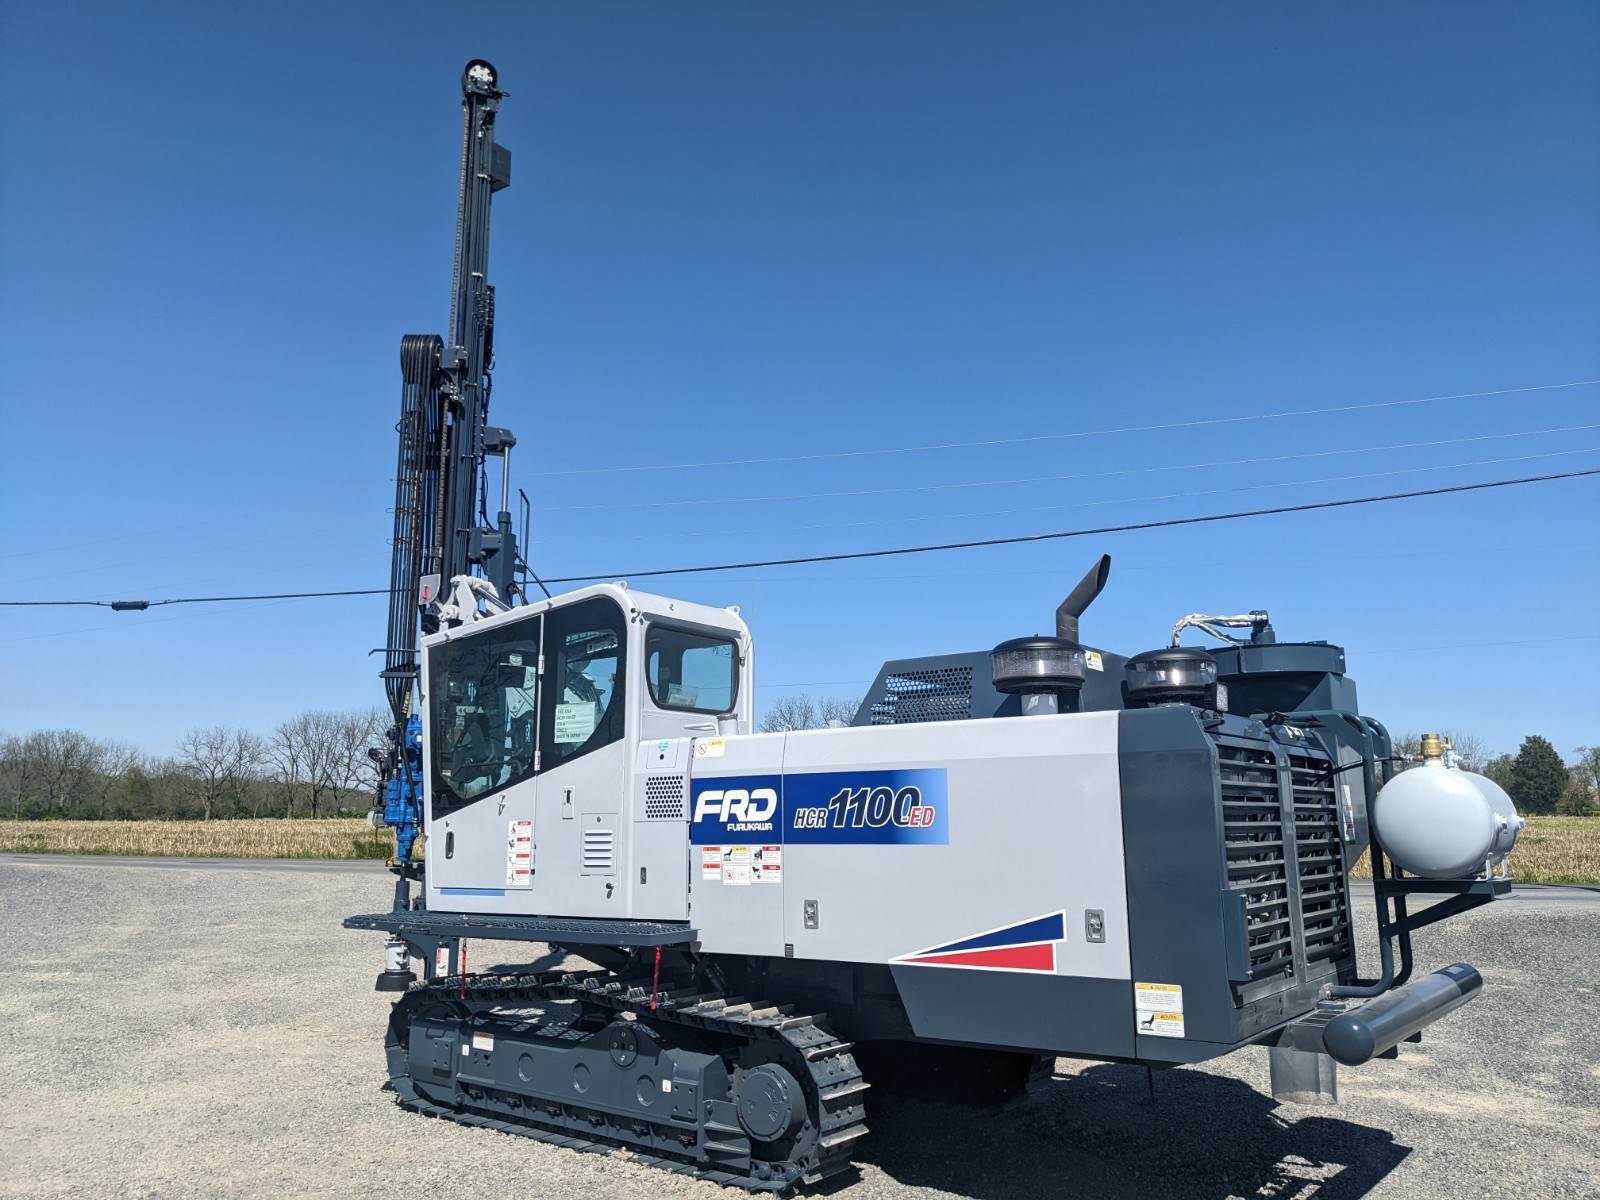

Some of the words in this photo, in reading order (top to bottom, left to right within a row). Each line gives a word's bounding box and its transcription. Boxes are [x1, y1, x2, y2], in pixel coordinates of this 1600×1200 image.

[693, 787, 777, 823] FRD
[793, 807, 828, 829] HCR
[828, 785, 921, 828] 1100
[727, 822, 773, 832] FURUKAWA
